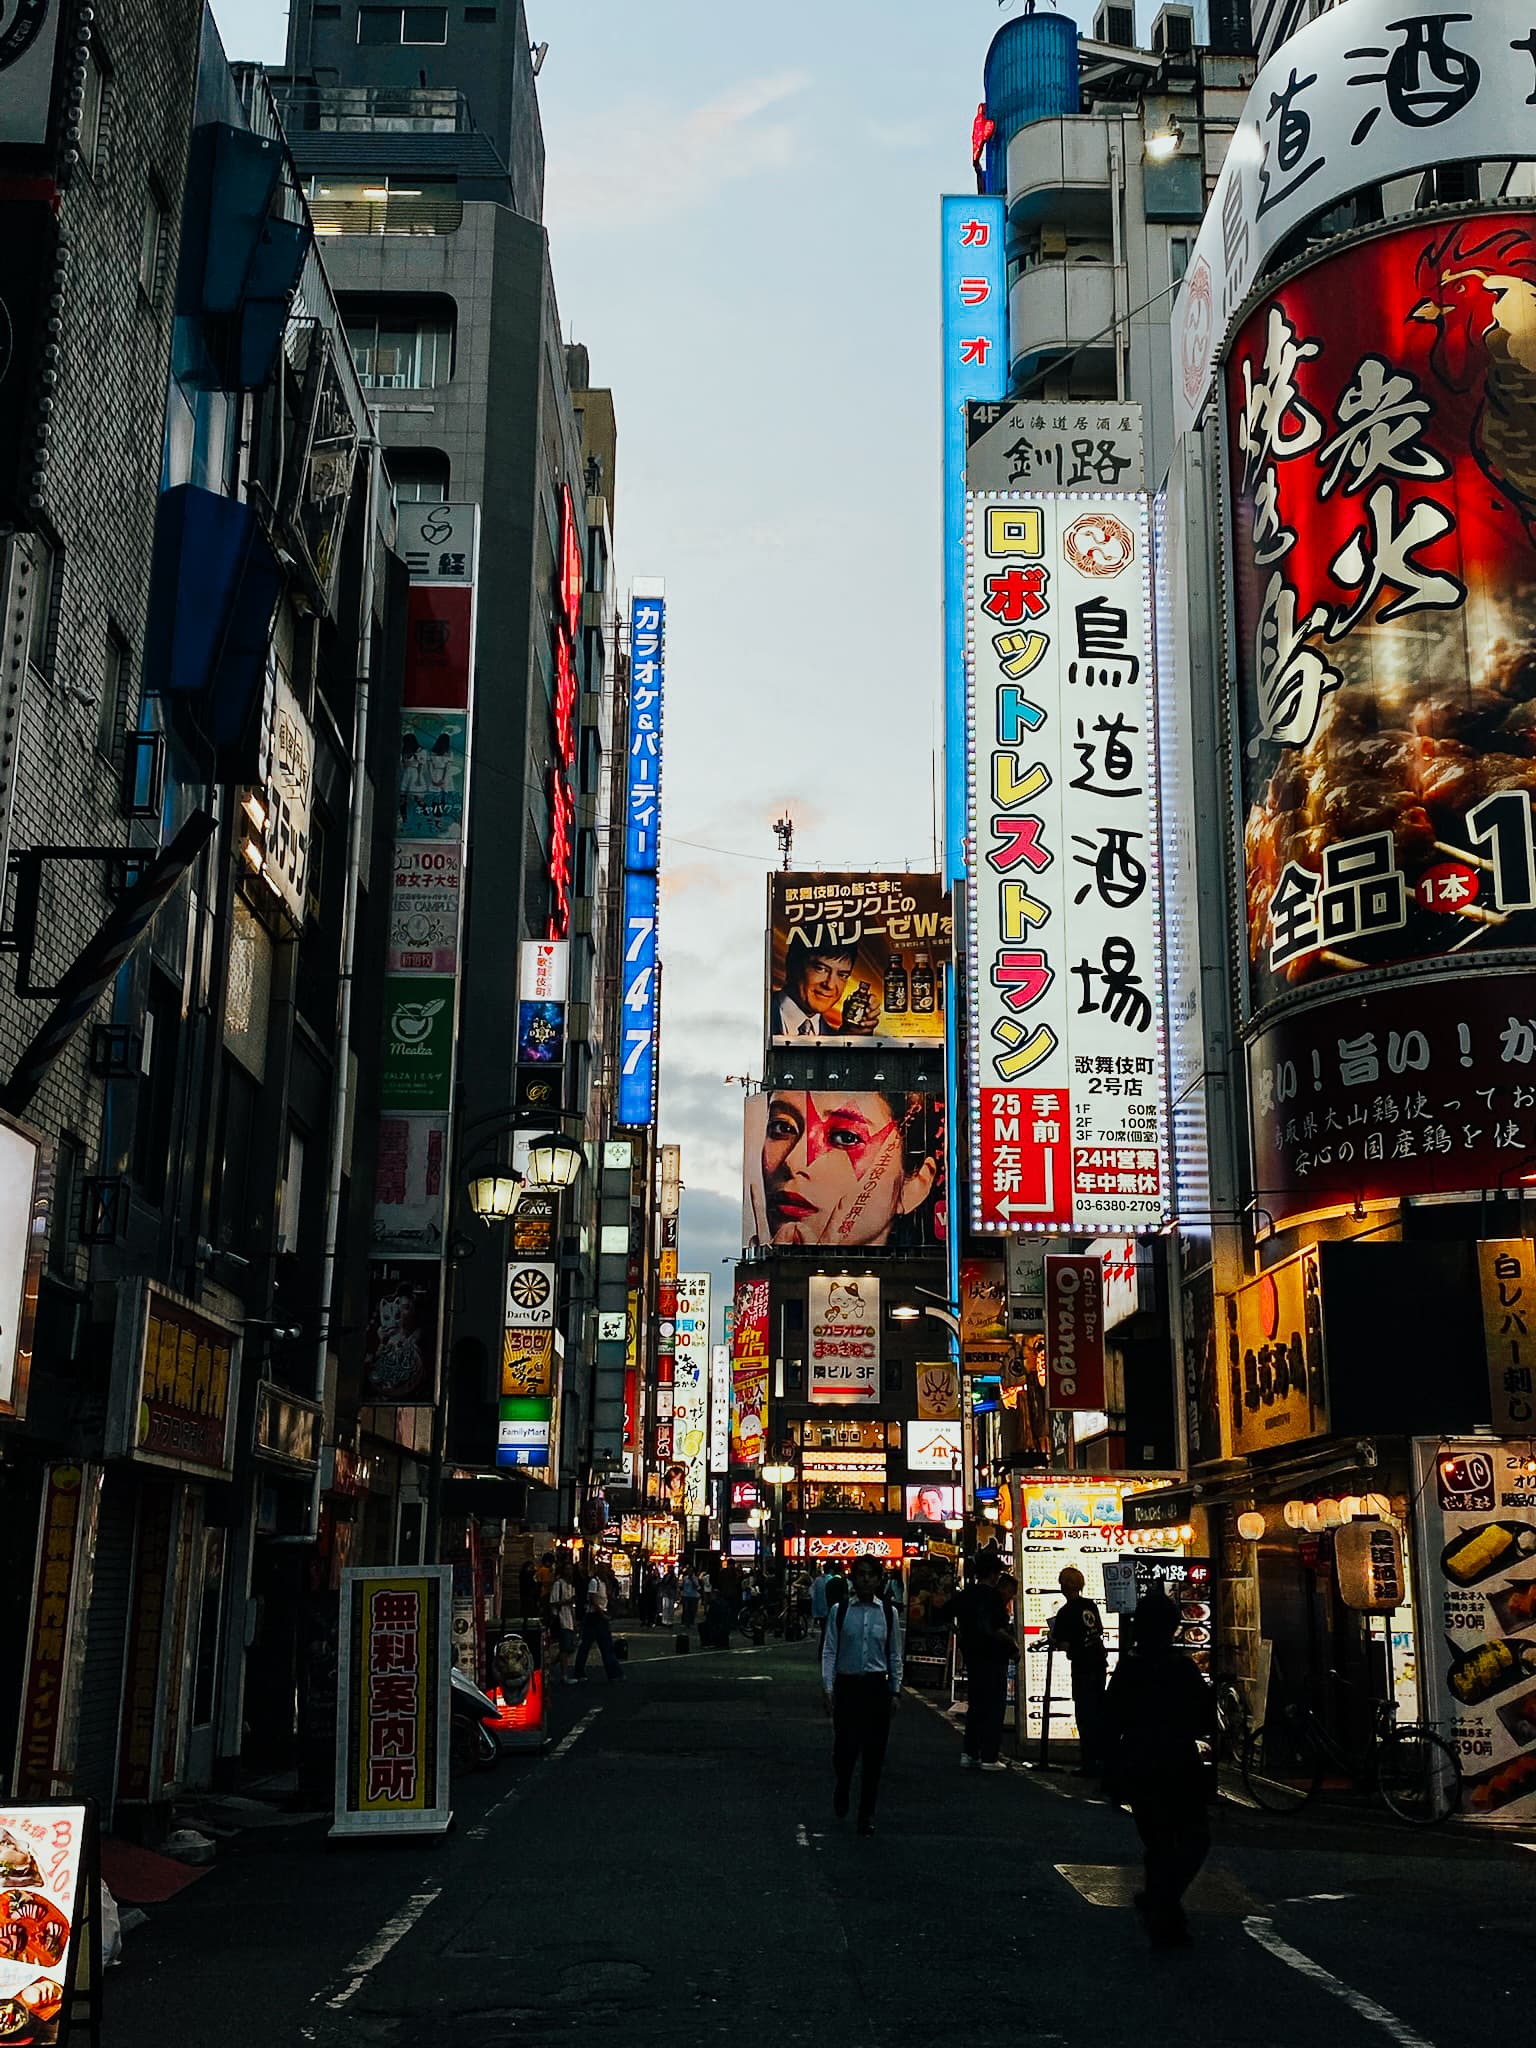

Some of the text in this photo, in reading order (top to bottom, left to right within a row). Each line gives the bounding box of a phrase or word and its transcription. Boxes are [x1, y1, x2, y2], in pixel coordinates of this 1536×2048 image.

[959, 220, 993, 364] カラオ
[972, 406, 1000, 424] 4F
[1009, 415, 1134, 433] 北海道居酒屋
[981, 505, 1059, 1082] ロボットレストラン
[1068, 596, 1153, 1033] 鳥道酒場
[393, 874, 458, 888] 役女子大生
[1420, 872, 1471, 904] 1本
[785, 895, 916, 923] ワンランク上の
[1268, 829, 1407, 973] 全品
[622, 917, 654, 1075] 747
[1074, 1055, 1155, 1076] 歌舞伎町
[1088, 1078, 1143, 1096] 2号店
[1032, 1094, 1060, 1144] 手前
[1075, 1103, 1157, 1117] 1F 60席
[1075, 1117, 1157, 1129] 2F 100席
[1076, 1130, 1093, 1141] 3F
[1076, 1149, 1159, 1171] 24H営業
[1076, 1173, 1158, 1194] 年中無休
[1076, 1199, 1161, 1213] 03-6380-2709
[531, 1310, 552, 1323] UP
[1053, 1266, 1081, 1396] Orange
[856, 1366, 875, 1379] 3F
[501, 1427, 547, 1439] FamilyMart
[1190, 1567, 1207, 1579] 4F
[369, 1591, 417, 1800] 無料案内所
